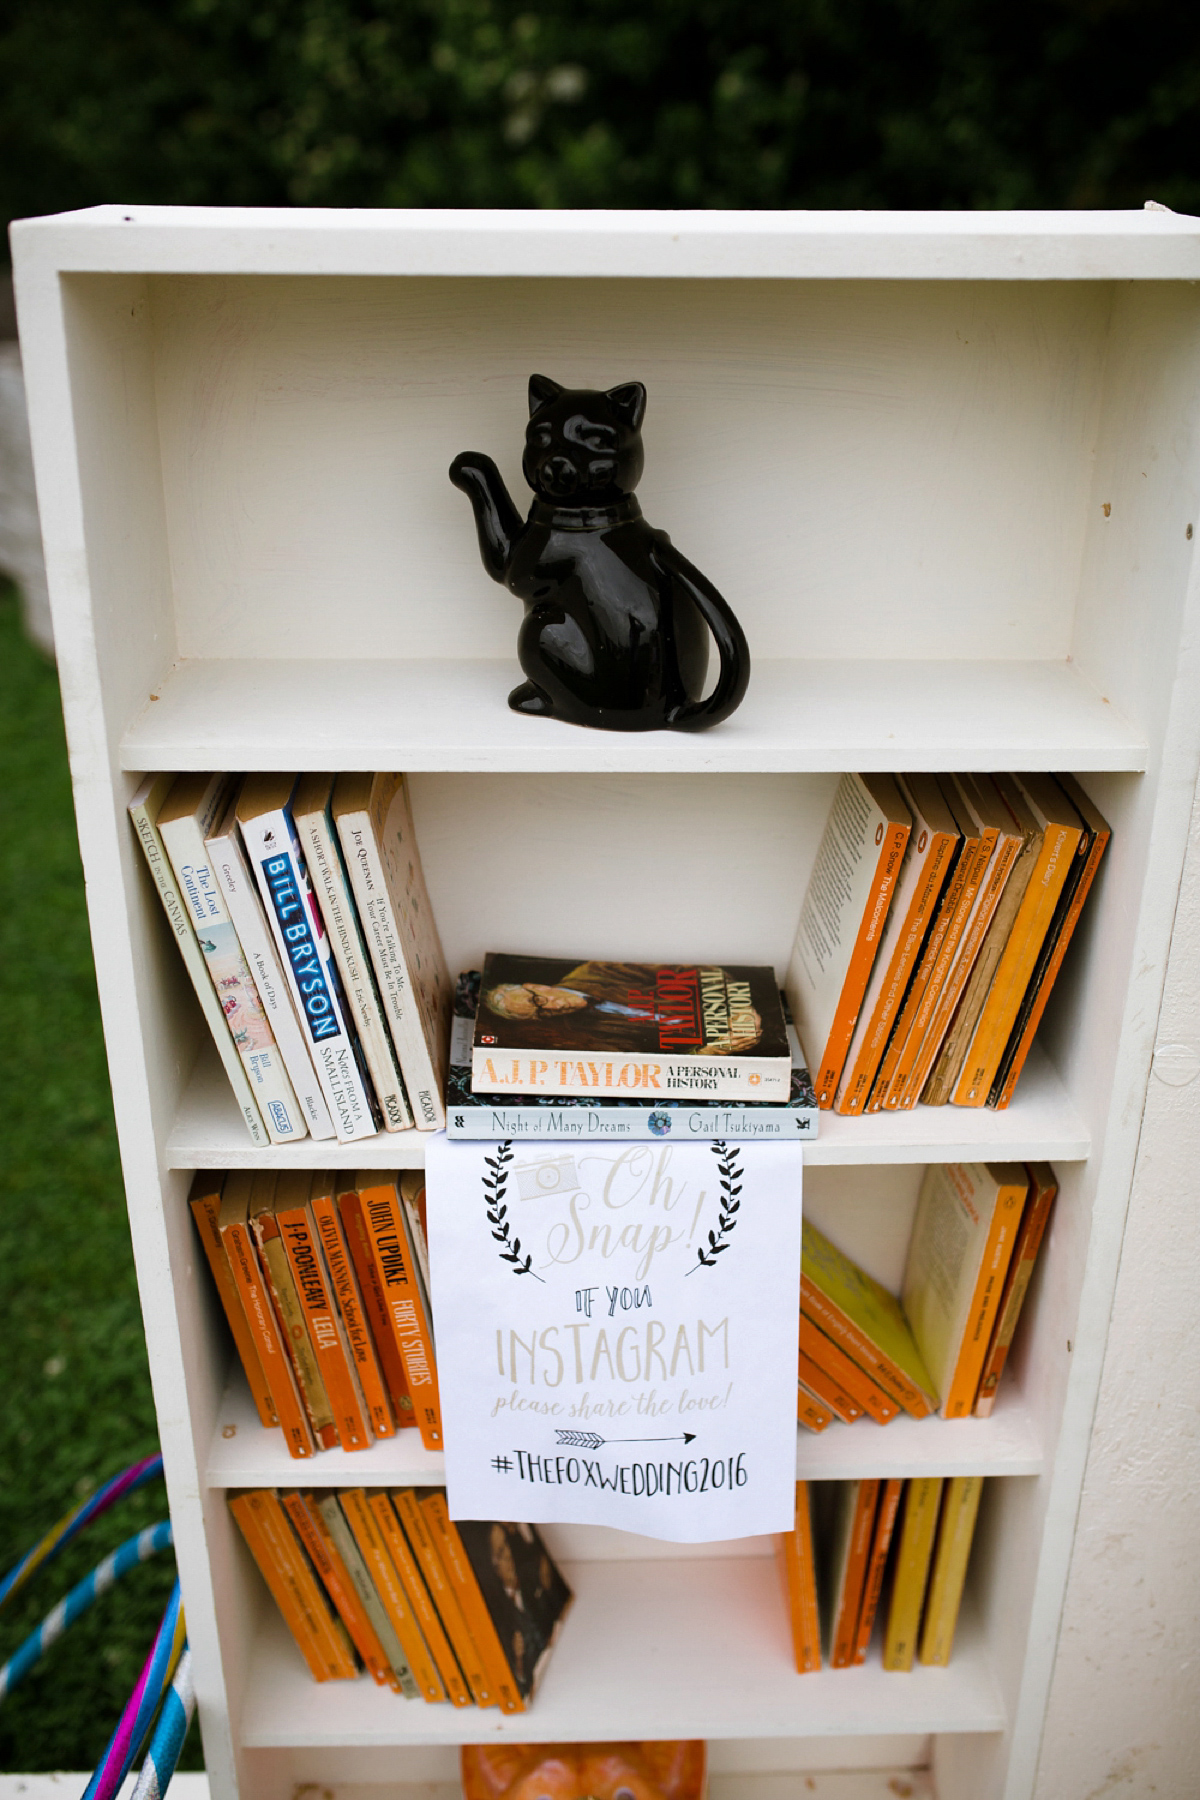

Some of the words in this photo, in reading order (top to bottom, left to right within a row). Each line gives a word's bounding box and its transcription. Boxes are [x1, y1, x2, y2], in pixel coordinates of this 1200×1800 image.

[350, 828, 365, 846] JOE
[1048, 829, 1068, 864] Kilvert's
[309, 834, 327, 866] SHORT
[319, 867, 334, 893] WALK
[884, 850, 899, 875] Snow
[930, 837, 949, 871] Daphne
[954, 844, 975, 882] Margaret
[134, 816, 162, 863] SKETCH
[161, 889, 188, 936] CANVAS
[195, 865, 213, 889] The
[219, 862, 239, 894] Greeley
[354, 847, 378, 891] QUEENAN
[879, 874, 892, 891] The
[927, 871, 937, 883] du
[967, 853, 987, 886] Naipaul
[1040, 862, 1056, 887] Diary
[179, 863, 208, 920] Continent
[203, 889, 222, 916] Lost
[375, 897, 384, 906] If
[943, 881, 961, 915] Drabble
[964, 886, 975, 898] Mr
[365, 899, 378, 919] Your
[377, 905, 391, 932] You're
[864, 891, 887, 942] Malcontents
[937, 915, 949, 932] The
[954, 898, 970, 924] Stone
[371, 920, 384, 946] Career
[910, 915, 922, 933] The
[949, 923, 961, 940] and
[252, 951, 261, 959] A
[268, 860, 291, 919] BILL
[286, 922, 337, 1038] BRYSON
[383, 933, 399, 963] Talking
[903, 933, 916, 952] Blue
[943, 939, 955, 954] the
[256, 960, 269, 980] Book
[378, 948, 390, 968] Must
[392, 963, 402, 974] To
[919, 961, 932, 981] Year
[931, 952, 950, 984] Knights
[384, 970, 393, 979] Be
[387, 981, 395, 990] In
[266, 990, 279, 1009] Days
[700, 968, 732, 1038] PERSONAL
[887, 981, 899, 998] and
[389, 991, 404, 1020] Trouble
[656, 969, 703, 1050] TAYLOR
[727, 981, 757, 1038] HISTORY
[879, 997, 894, 1020] Other
[915, 983, 939, 1028] Companion
[247, 1054, 265, 1084] Bryson
[258, 1052, 271, 1068] Bill
[334, 1047, 354, 1079] Notes
[553, 1060, 662, 1089] TAYLOR
[666, 1065, 675, 1077] A
[676, 1066, 741, 1079] PERSONAL
[319, 1046, 341, 1091] SMALL
[332, 1089, 355, 1136] ISLAND
[343, 1079, 360, 1113] FROM
[666, 1078, 720, 1090] HISTORY
[269, 1101, 289, 1132] ABACUS
[304, 1095, 319, 1121] Blackie
[354, 1113, 362, 1121] A
[383, 1093, 402, 1126] PICADOR
[417, 1089, 436, 1123] PICADOR
[492, 1112, 529, 1134] Night
[534, 1116, 542, 1132] of
[547, 1112, 583, 1136] Many
[588, 1113, 631, 1133] Dreams
[689, 1113, 719, 1133] Gail
[724, 1113, 781, 1137] Tsukiyama
[578, 1145, 687, 1211] Oh
[367, 1196, 395, 1234] JOHN
[230, 1229, 245, 1258] Graham
[318, 1214, 340, 1250] OLIVIA
[540, 1191, 706, 1281] Snap!
[328, 1249, 352, 1296] MANNING
[376, 1233, 408, 1288] UPDIKE
[248, 1284, 258, 1298] The
[575, 1287, 600, 1317] IF
[605, 1285, 653, 1317] YOU
[251, 1298, 268, 1330] Honorary
[341, 1297, 360, 1327] School
[391, 1297, 421, 1341] FORTY
[311, 1313, 337, 1350] LEILA
[349, 1327, 365, 1342] for
[353, 1341, 370, 1363] Love
[401, 1337, 432, 1388] STORIES
[496, 1317, 730, 1387] INSTAGRAM
[491, 1390, 565, 1417] please
[568, 1391, 629, 1420] share
[632, 1391, 673, 1416] the
[677, 1382, 733, 1415] love!
[490, 1450, 748, 1497] #THEFOXWEDDING2016
